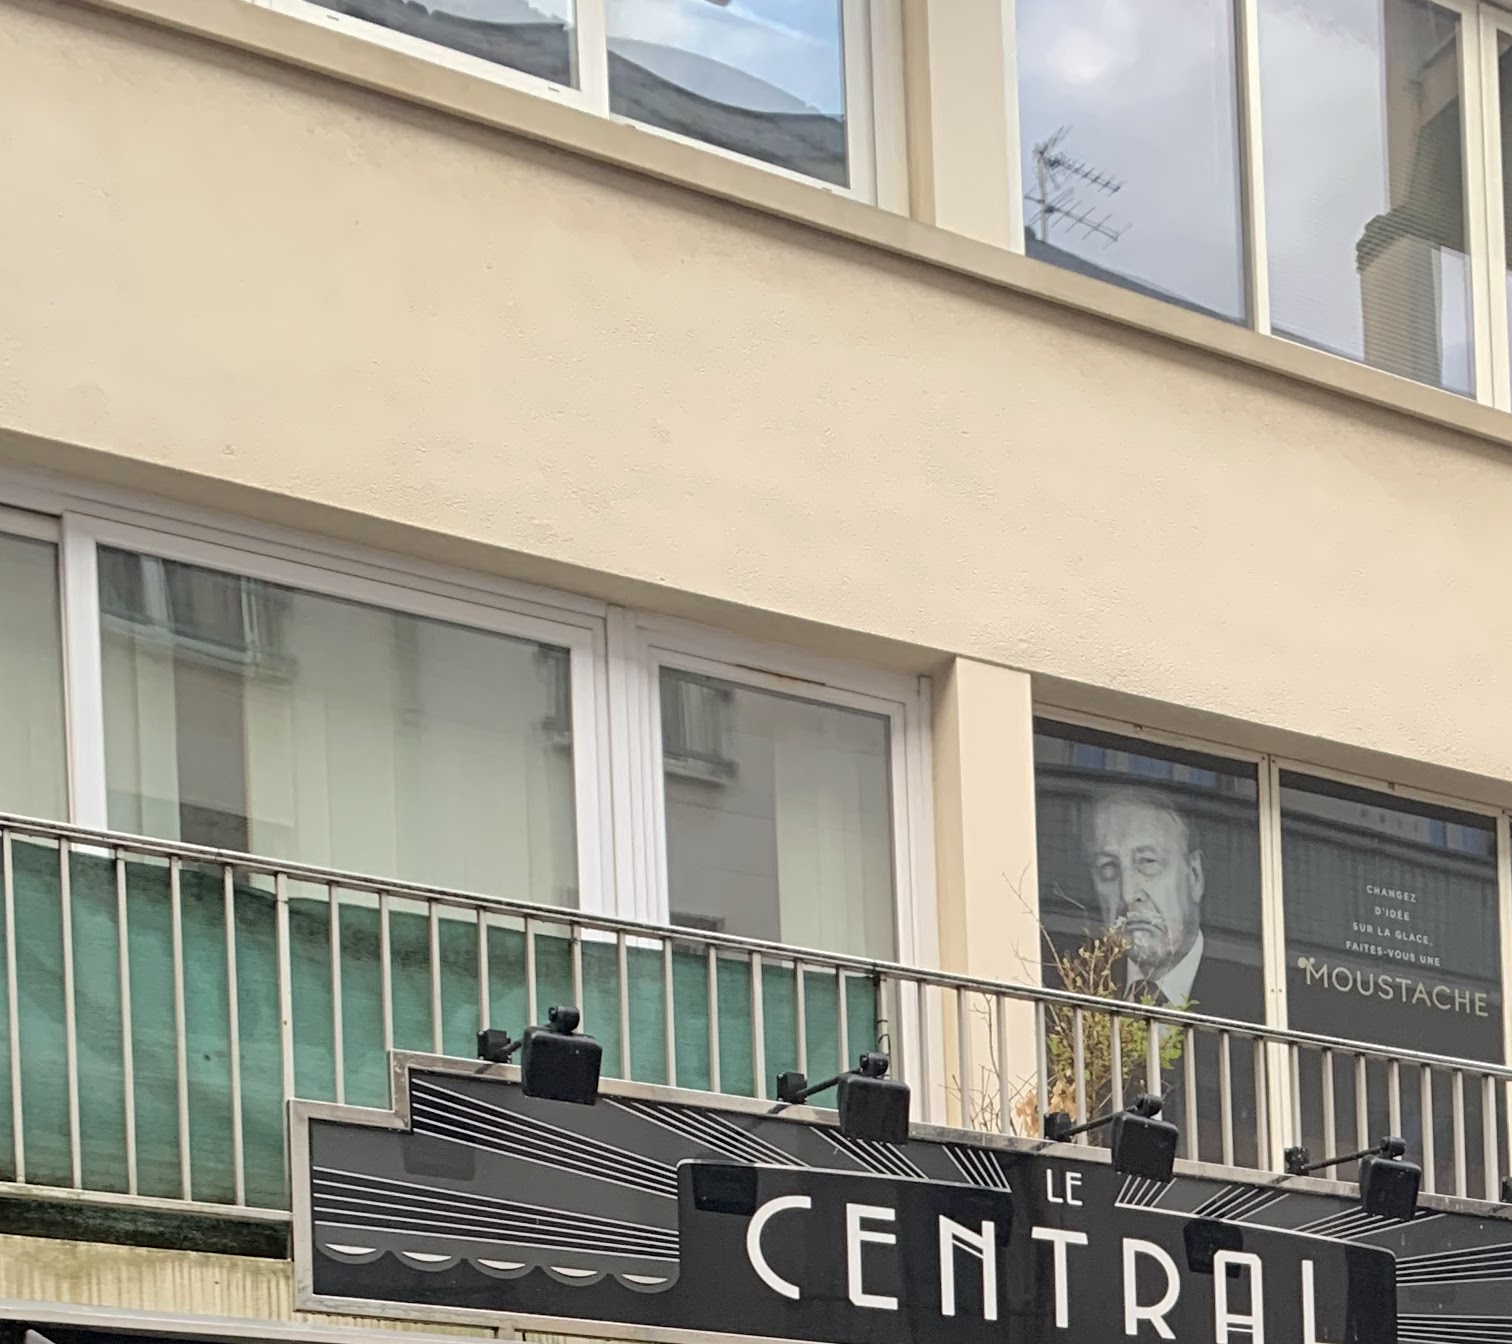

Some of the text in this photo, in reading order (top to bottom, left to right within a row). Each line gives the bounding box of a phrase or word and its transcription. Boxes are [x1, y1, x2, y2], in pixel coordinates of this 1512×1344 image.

[1366, 885, 1417, 902] CHANGEZ
[1375, 906, 1410, 921] D'IDÉE
[1353, 922, 1373, 933] SUR
[1378, 926, 1390, 937] LA
[1346, 941, 1441, 966] FAITES-VOUS UNE
[1300, 960, 1488, 1016] MOUSTACHE
[1046, 1168, 1083, 1206] LE
